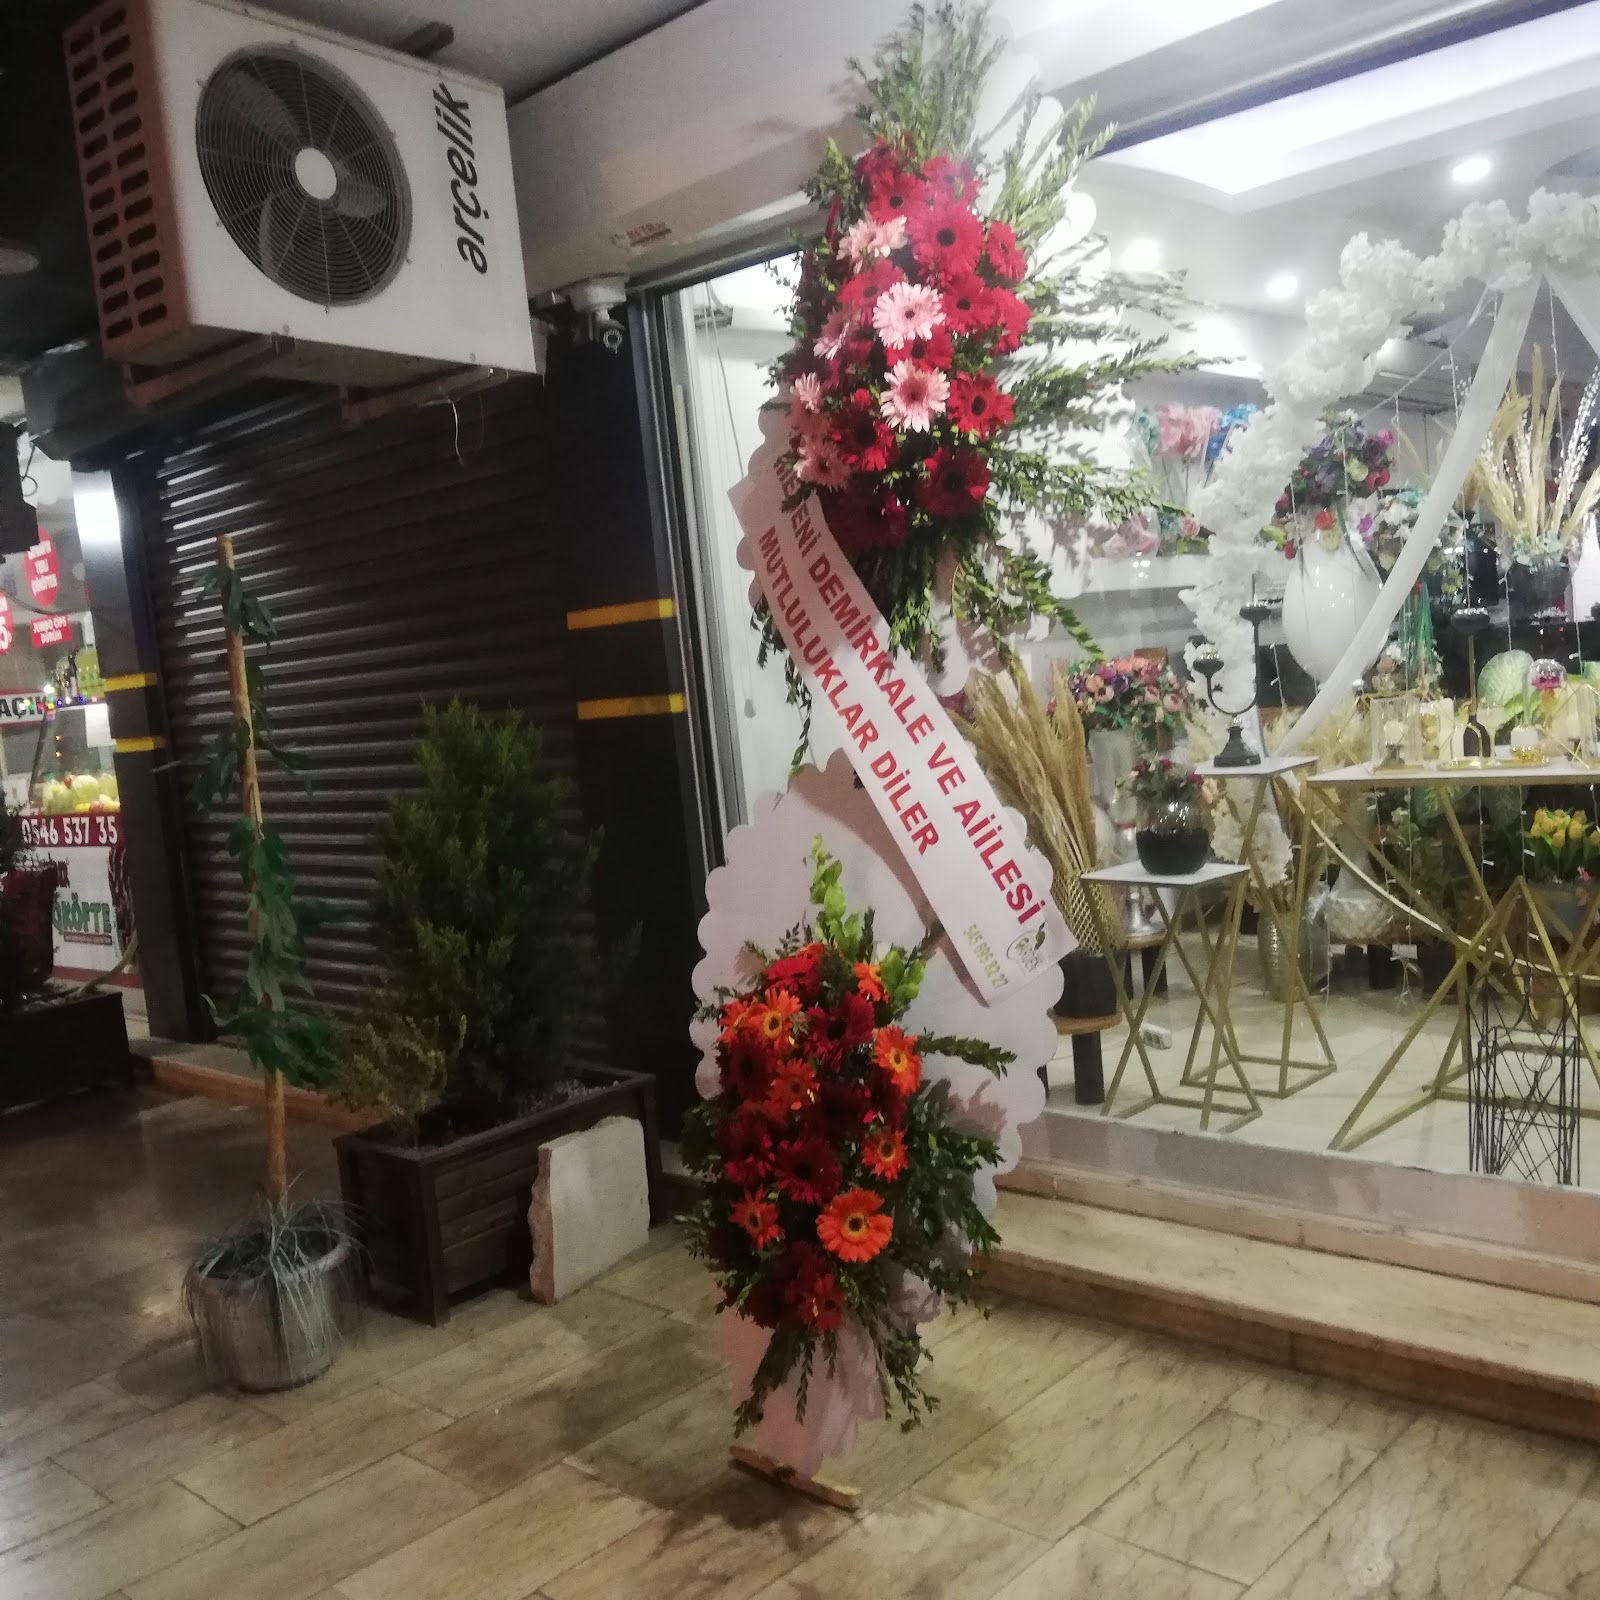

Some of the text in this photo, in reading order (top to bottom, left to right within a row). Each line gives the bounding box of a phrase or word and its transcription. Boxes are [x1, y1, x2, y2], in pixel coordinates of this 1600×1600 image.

[433, 82, 489, 274] arçelik
[759, 525, 939, 856] MUTLULUKLAR DİLER
[808, 553, 935, 744] DEMİRKALE
[927, 742, 966, 796] VE
[953, 800, 1046, 925] AİİLESİ
[21, 815, 118, 845] 0546 537 35
